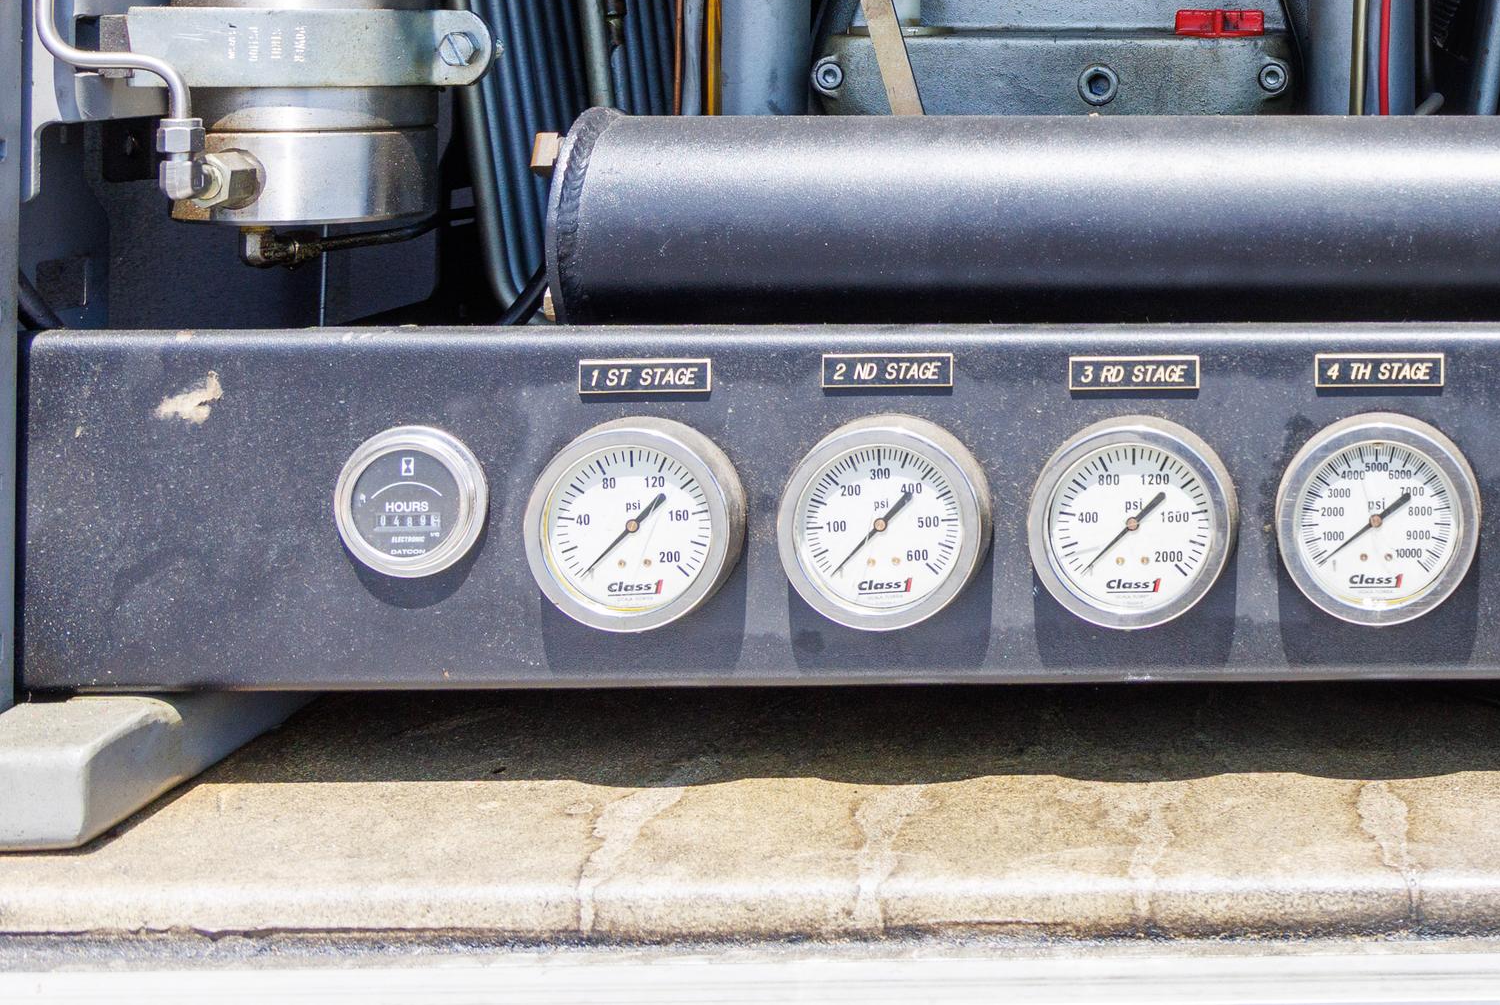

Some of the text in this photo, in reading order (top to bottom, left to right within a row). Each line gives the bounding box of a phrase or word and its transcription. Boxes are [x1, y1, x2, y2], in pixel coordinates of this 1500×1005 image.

[834, 362, 942, 380] 2 ND STAGE
[1081, 365, 1188, 383] 3 RD STAGE
[1327, 363, 1433, 380] 4 TH STAGE
[591, 367, 698, 387] 1 ST STAGE
[1365, 462, 1389, 472] 5000
[870, 469, 890, 480] 300
[1098, 474, 1120, 485] 800
[1140, 474, 1170, 485] 1200
[1341, 470, 1365, 480] 4000
[1388, 470, 1412, 480] 6000
[602, 477, 616, 489] 80
[645, 476, 665, 488] 120
[840, 485, 861, 496] 200
[900, 483, 922, 495] 400
[1328, 488, 1351, 498] 3000
[1400, 486, 1424, 496] 7000
[386, 501, 429, 512] HOURS
[626, 501, 641, 513] psi
[874, 499, 889, 511] psi
[1125, 500, 1143, 512] psi
[1368, 498, 1386, 512] psi
[669, 510, 689, 522] 160
[1321, 507, 1344, 517] 2000
[1408, 507, 1433, 516] 8000
[576, 514, 590, 525] 40
[918, 517, 940, 528] 500
[1078, 512, 1099, 523] 400
[1161, 512, 1189, 523] 1600
[826, 521, 847, 532] 100
[1323, 531, 1344, 541] 1000
[1406, 530, 1430, 540] 9000
[659, 551, 681, 563] 200
[906, 550, 929, 561] 600
[1155, 551, 1183, 563] 2000
[1395, 548, 1422, 559] 10000
